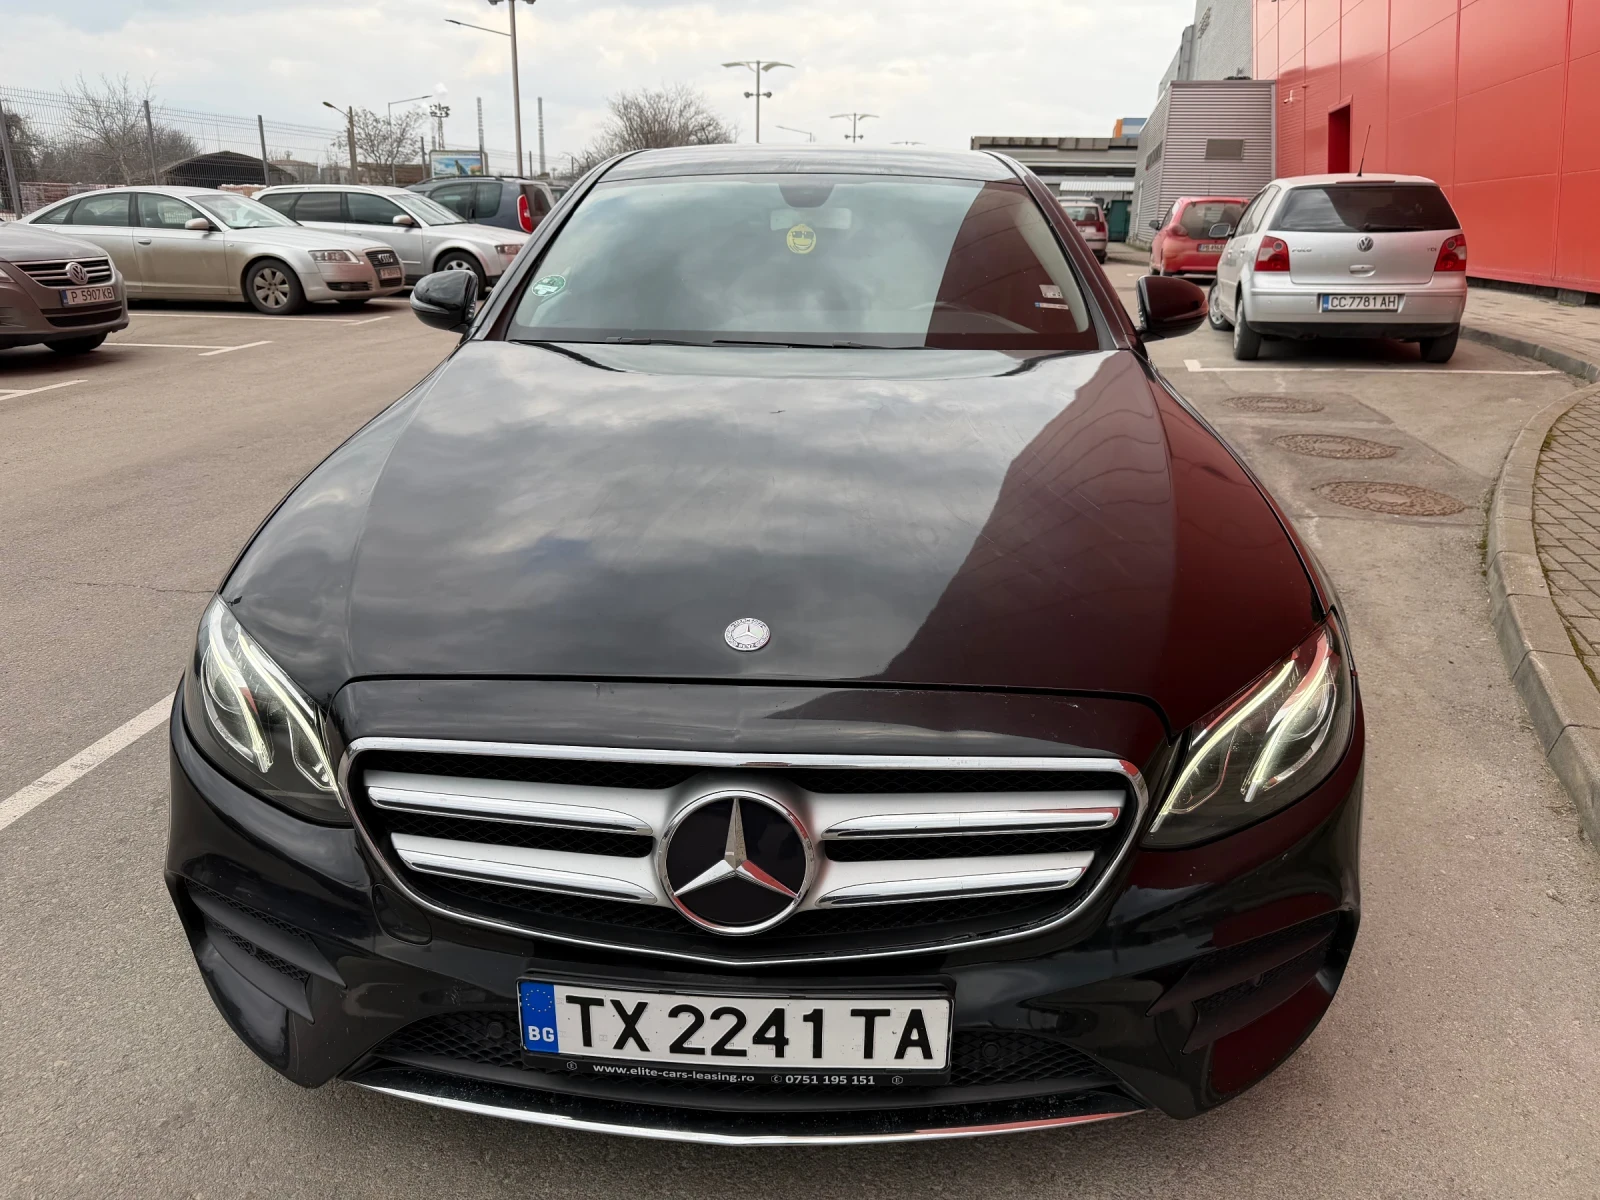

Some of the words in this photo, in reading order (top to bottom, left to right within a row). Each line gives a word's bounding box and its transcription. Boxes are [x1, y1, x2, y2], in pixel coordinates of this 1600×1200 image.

[71, 291, 78, 302] P
[81, 289, 101, 301] 5907
[102, 288, 113, 299] KB
[1330, 296, 1347, 308] CC
[1349, 296, 1377, 308] 7781
[1380, 296, 1396, 308] AH
[528, 1025, 555, 1042] BG
[565, 994, 651, 1052] TX
[668, 1004, 824, 1059] 2241
[850, 1008, 934, 1060] TA
[593, 1064, 755, 1083] www.elite-cars-leasing.ro
[785, 1075, 819, 1085] 0751
[823, 1075, 848, 1085] 195
[851, 1075, 876, 1085] 151
